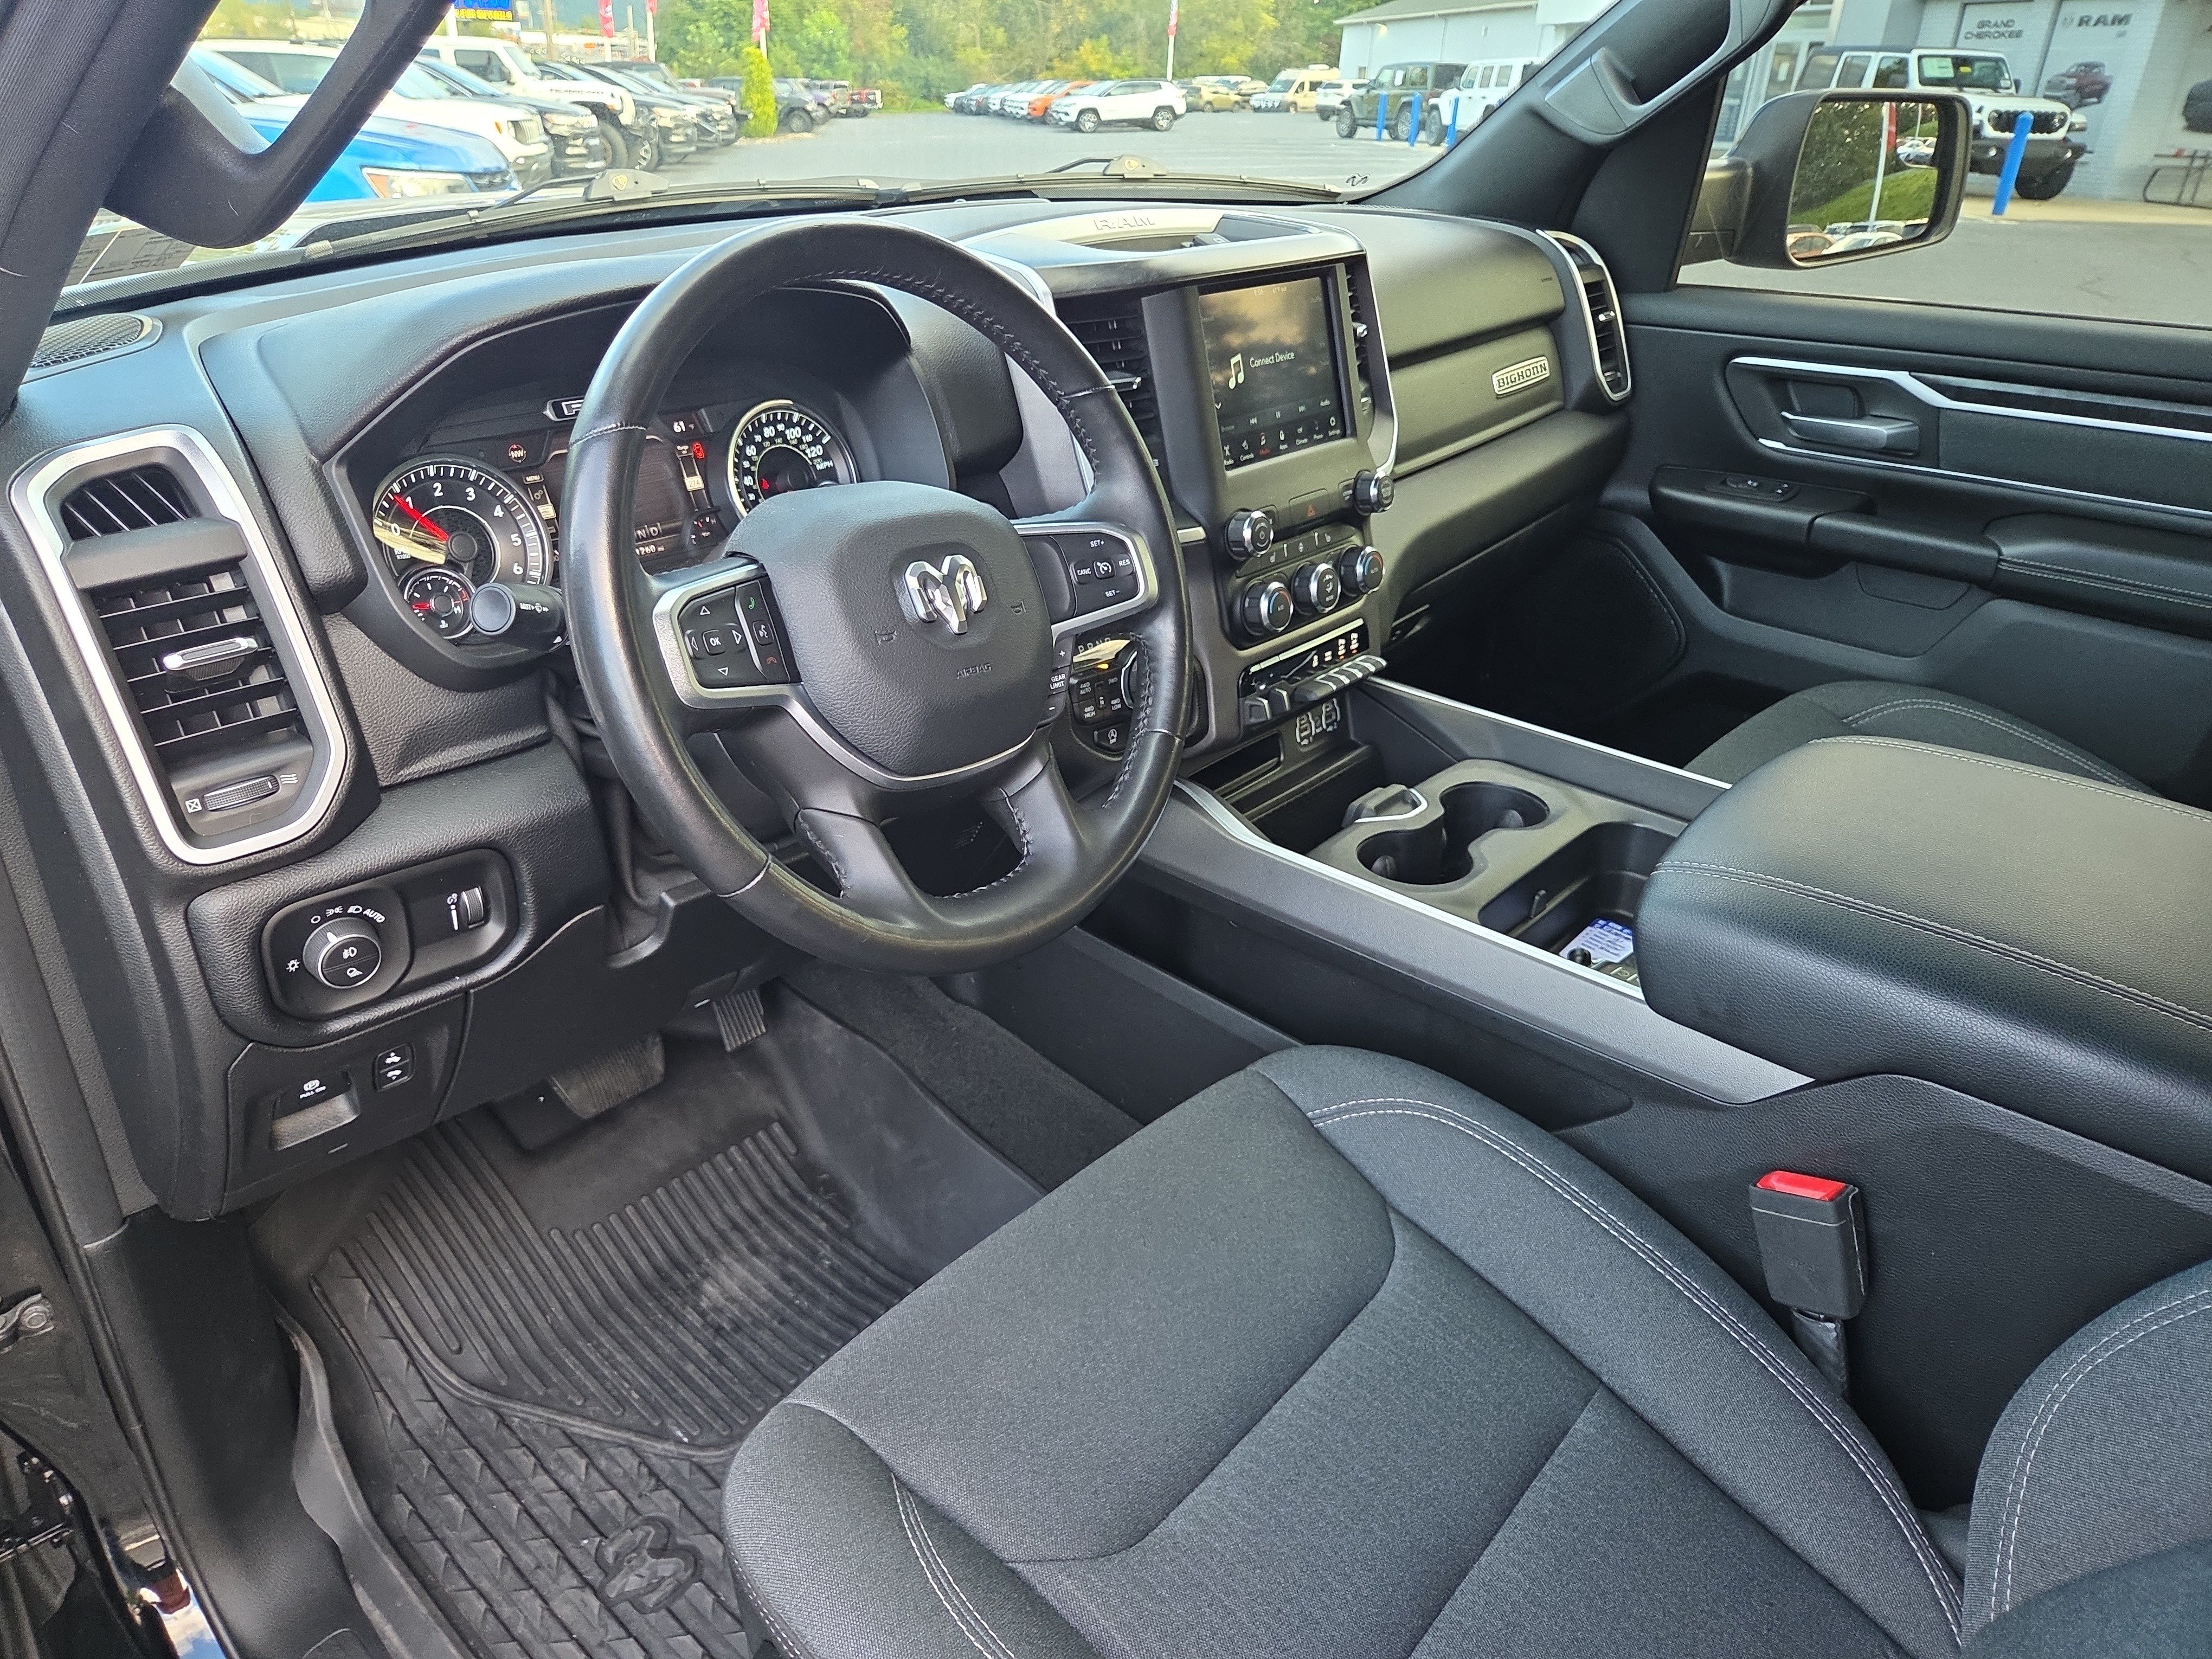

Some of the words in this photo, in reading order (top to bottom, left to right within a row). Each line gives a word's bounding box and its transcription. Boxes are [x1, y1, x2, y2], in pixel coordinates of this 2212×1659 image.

[1978, 20, 2015, 29] GRAND
[2078, 14, 2133, 27] RAM
[1964, 30, 2023, 40] CHEROKEE
[1094, 216, 1155, 230] RAM
[1249, 357, 1276, 368] Connect
[1275, 350, 1295, 363] Device
[1497, 363, 1547, 388] BIGHORN
[673, 420, 686, 433] 61
[763, 425, 775, 438] 80
[785, 426, 802, 440] 100
[754, 434, 762, 443] 70
[802, 434, 813, 443] 110
[745, 445, 757, 456] 60
[805, 444, 824, 459] 120
[815, 459, 834, 471] MPH
[743, 475, 754, 486] 40
[433, 482, 443, 497] 2
[465, 487, 476, 501] 3
[406, 496, 414, 509] 1
[493, 505, 504, 518] 4
[390, 523, 401, 536] 0
[511, 533, 522, 546] 5
[513, 562, 524, 575] 6
[1118, 558, 1130, 567] RES
[1077, 568, 1092, 576] CANC
[709, 636, 722, 647] OK
[956, 663, 992, 679] AIRBAG
[1051, 673, 1066, 683] GEAR
[1050, 680, 1065, 690] LIMIT
[363, 908, 385, 923] AUTO
